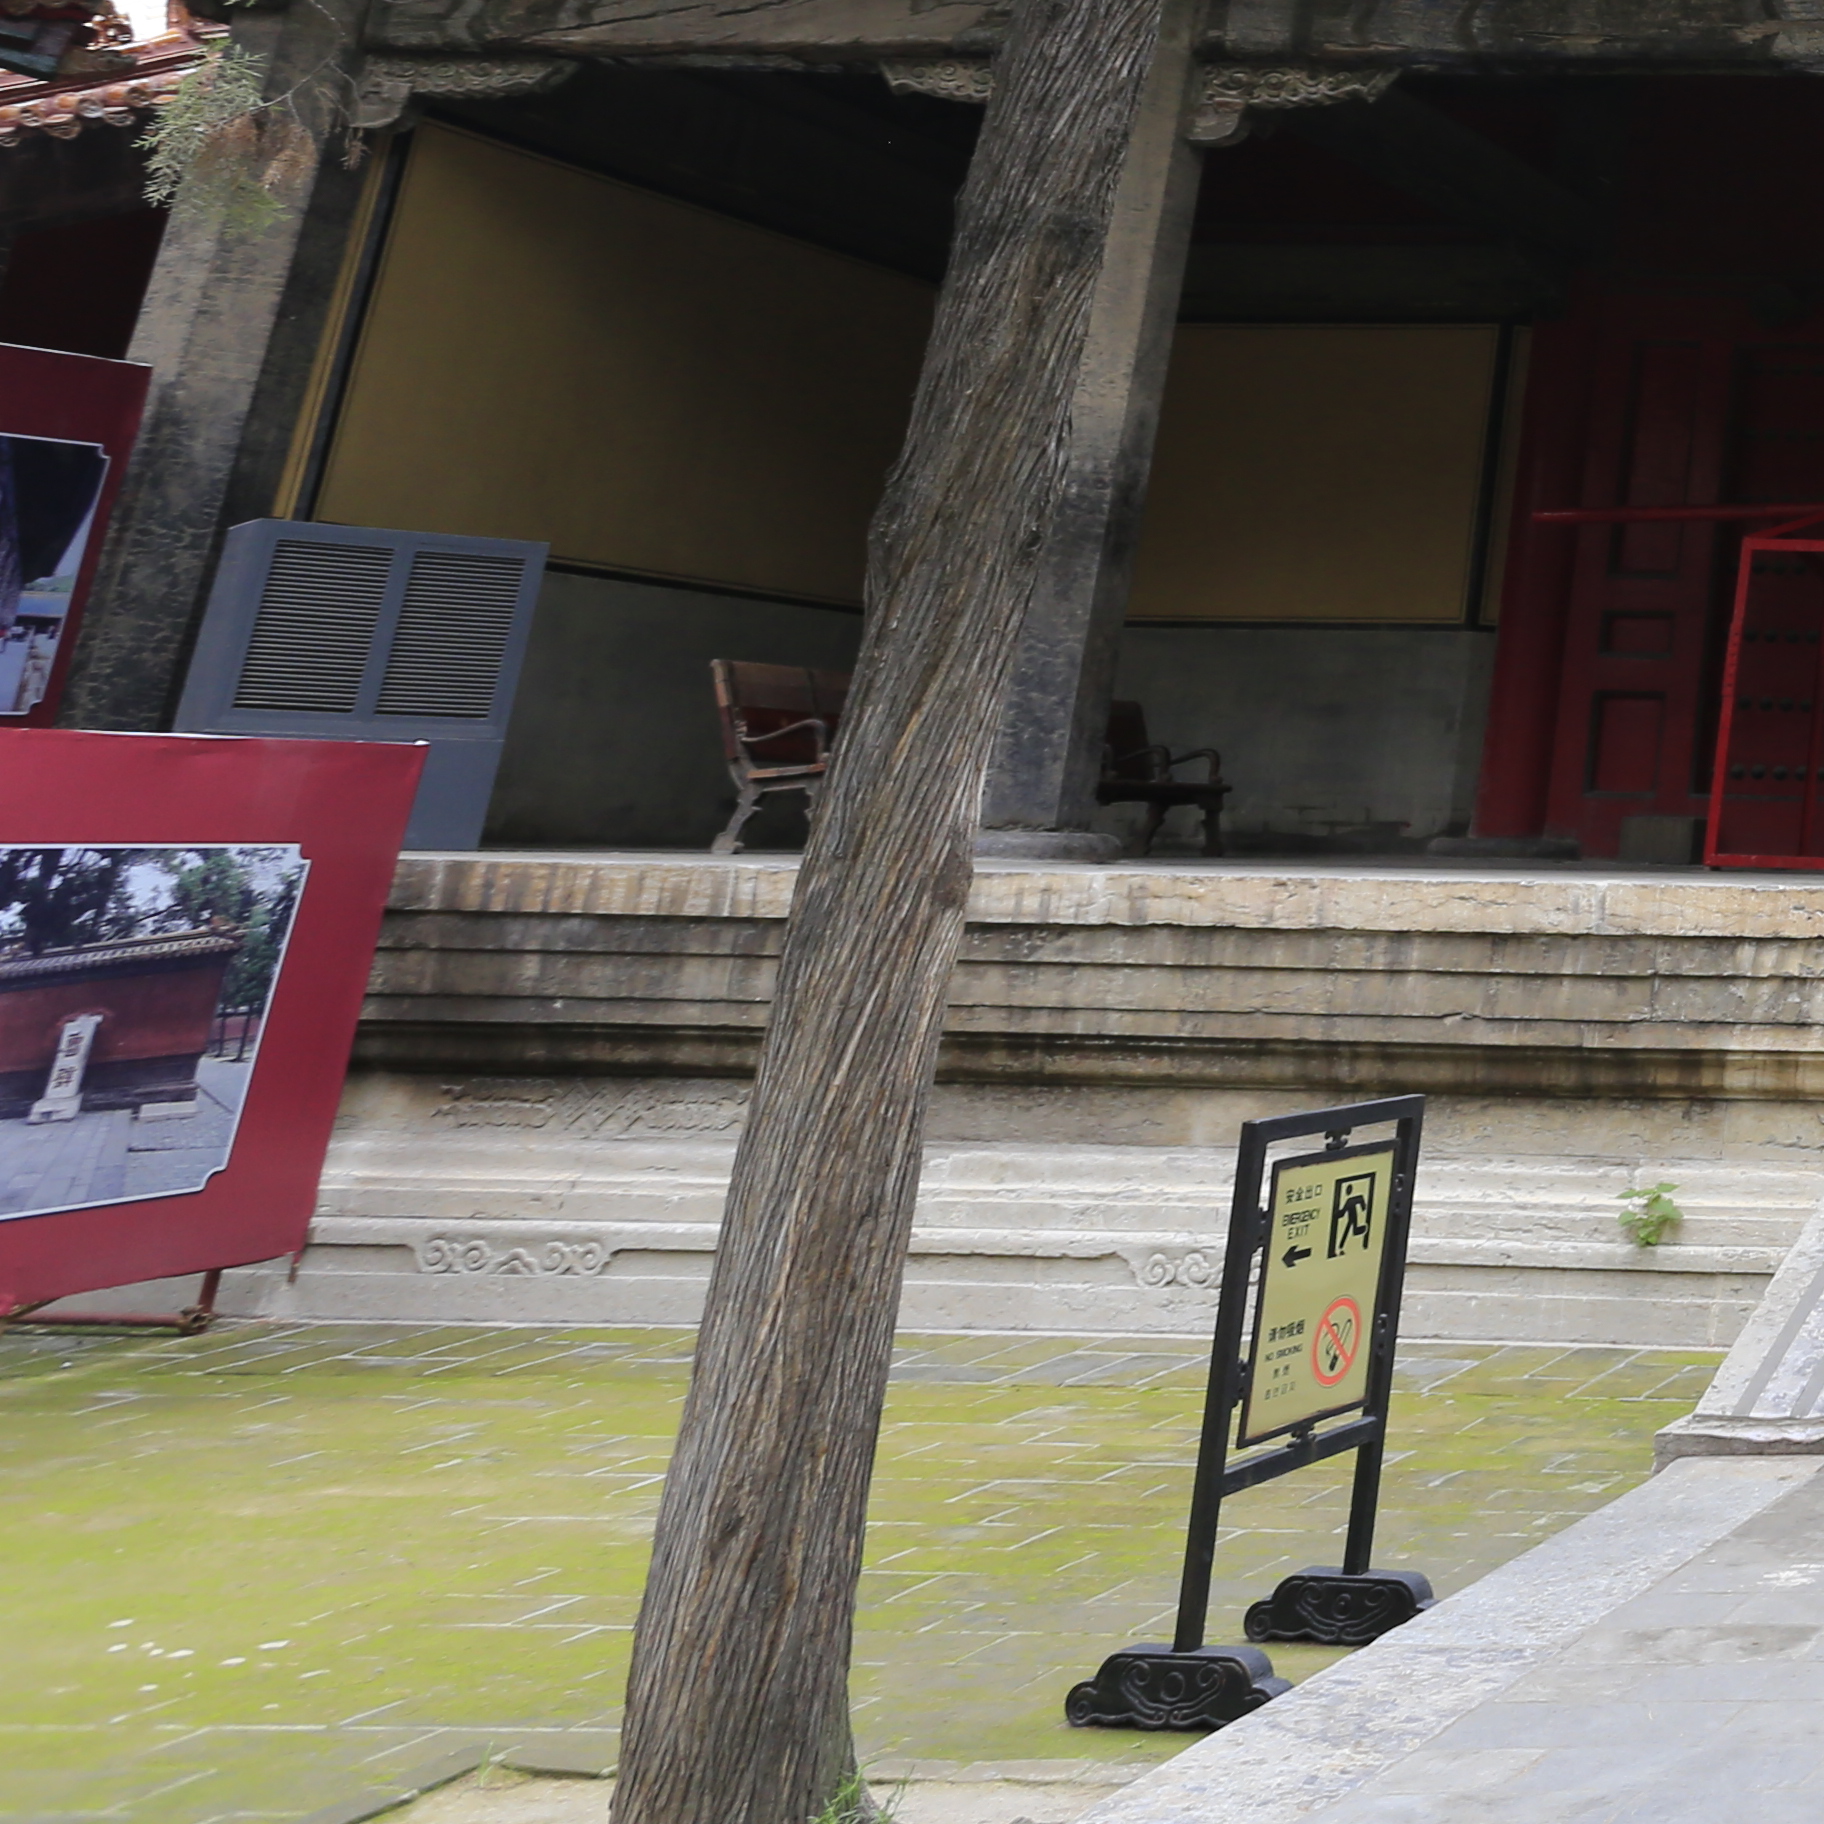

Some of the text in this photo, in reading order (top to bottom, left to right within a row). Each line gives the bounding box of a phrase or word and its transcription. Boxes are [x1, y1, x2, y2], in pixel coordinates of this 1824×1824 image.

[1286, 1184, 1322, 1204] 安全出口
[1287, 1224, 1309, 1239] EXIT
[1268, 1319, 1305, 1342] 请勿吸烟
